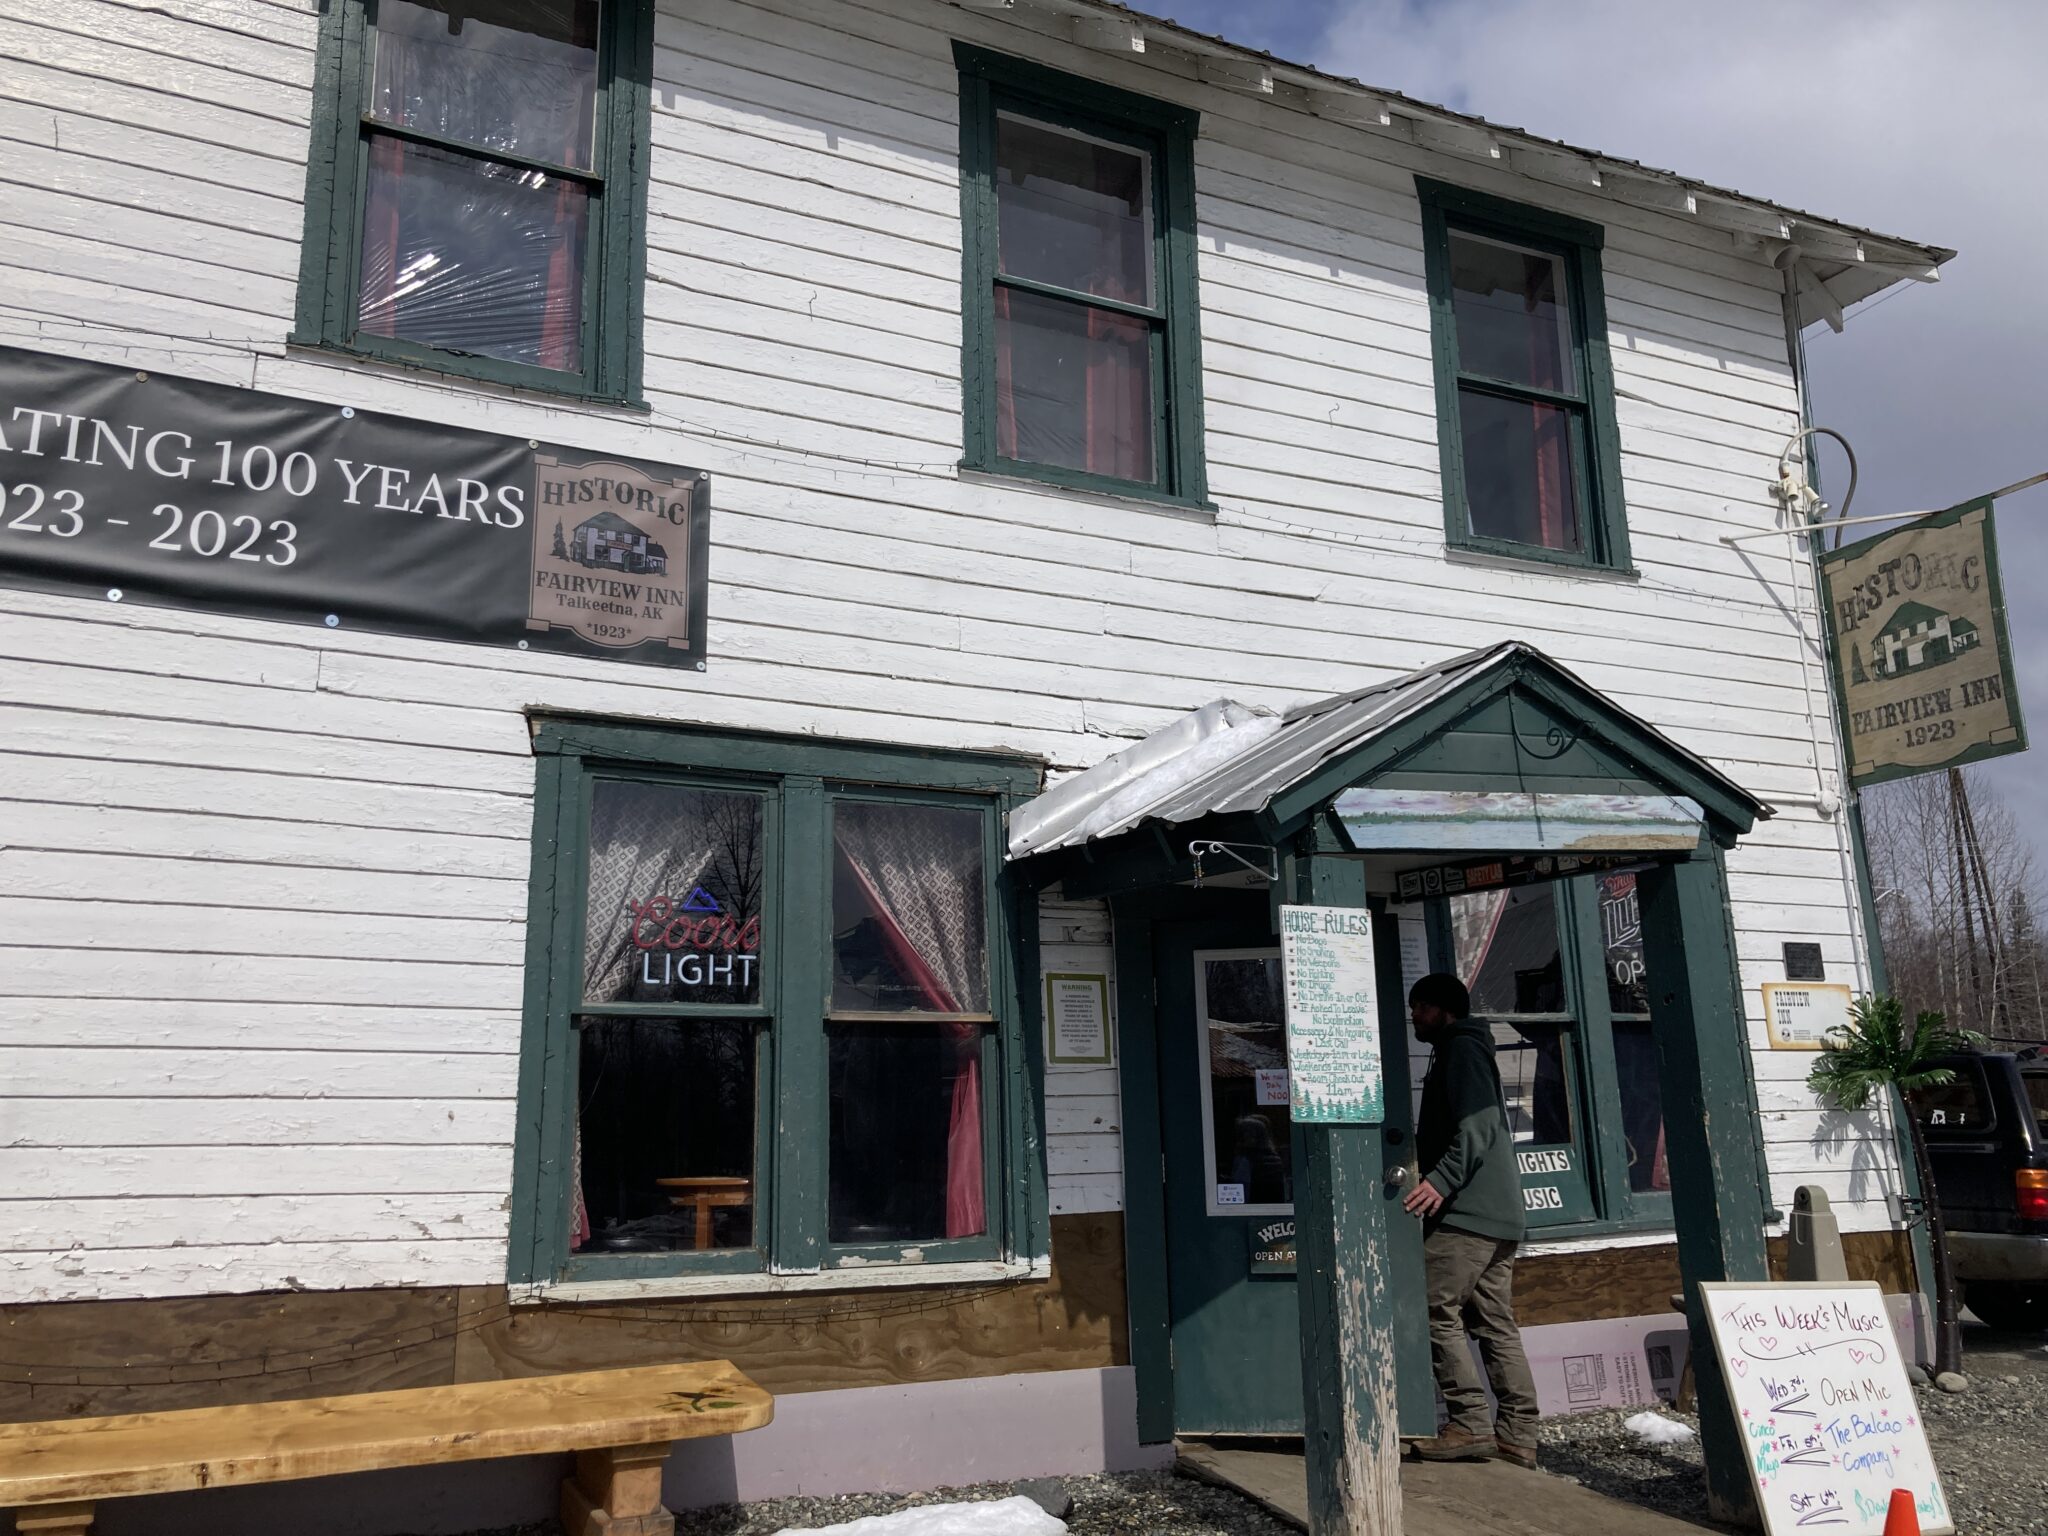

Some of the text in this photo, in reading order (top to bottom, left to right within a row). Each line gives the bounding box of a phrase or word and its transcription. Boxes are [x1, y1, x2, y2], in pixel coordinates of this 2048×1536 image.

[213, 439, 317, 496] 100
[333, 458, 526, 529] YEARS
[543, 477, 685, 526] HISTORIC
[0, 482, 85, 537] 23
[149, 503, 297, 566] 2023
[536, 571, 684, 607] FAIRVIEW INN
[556, 593, 663, 620] Talkeetna, AK
[1852, 673, 2002, 737] FAIRVIEW INN
[1905, 719, 1956, 748] 1923
[631, 896, 760, 950] Coors
[1284, 910, 1368, 935] HOUSE RULES
[1296, 935, 1306, 944] No
[1297, 947, 1306, 956] No
[643, 953, 757, 986] LIGHT
[1297, 958, 1306, 967] No
[1297, 969, 1306, 978] No
[1298, 980, 1306, 989] No
[1334, 1039, 1348, 1048] Call
[1518, 1151, 1569, 1173] IGHTS
[1255, 1251, 1282, 1261] OPEN
[1721, 1302, 1766, 1332] THIS
[1760, 1377, 1788, 1401] WED
[1820, 1377, 1859, 1406] OPEN
[1863, 1378, 1892, 1401] MIC
[1749, 1422, 1776, 1438] Cinco
[1779, 1434, 1798, 1450] FRI
[1825, 1417, 1851, 1449] The
[1757, 1456, 1780, 1480] Mayo
[1842, 1449, 1895, 1479] Company
